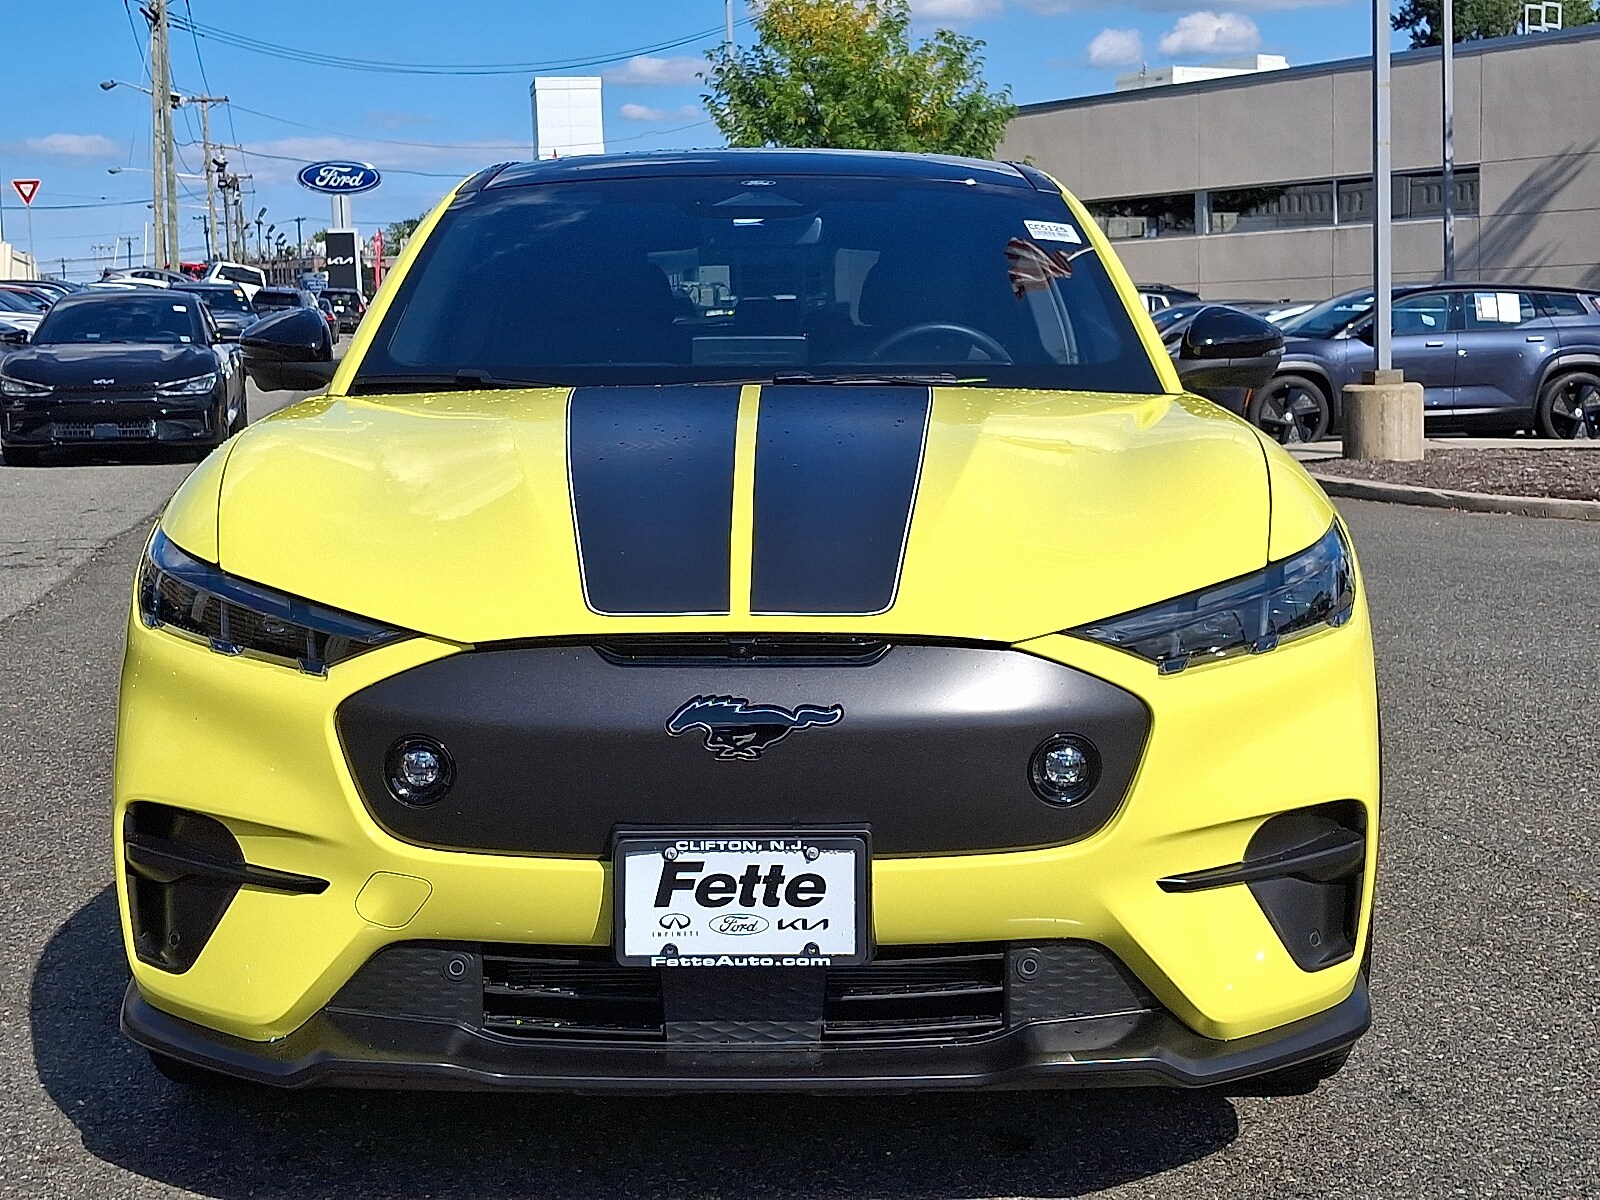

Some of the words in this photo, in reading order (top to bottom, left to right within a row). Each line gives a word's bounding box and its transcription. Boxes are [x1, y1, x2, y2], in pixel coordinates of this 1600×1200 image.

[315, 165, 364, 187] Ford
[675, 840, 763, 852] CLIFTON,
[770, 840, 808, 851] N.J.
[653, 860, 827, 908] Fette
[719, 915, 758, 934] Ford
[650, 956, 831, 967] FetteAuto.com
